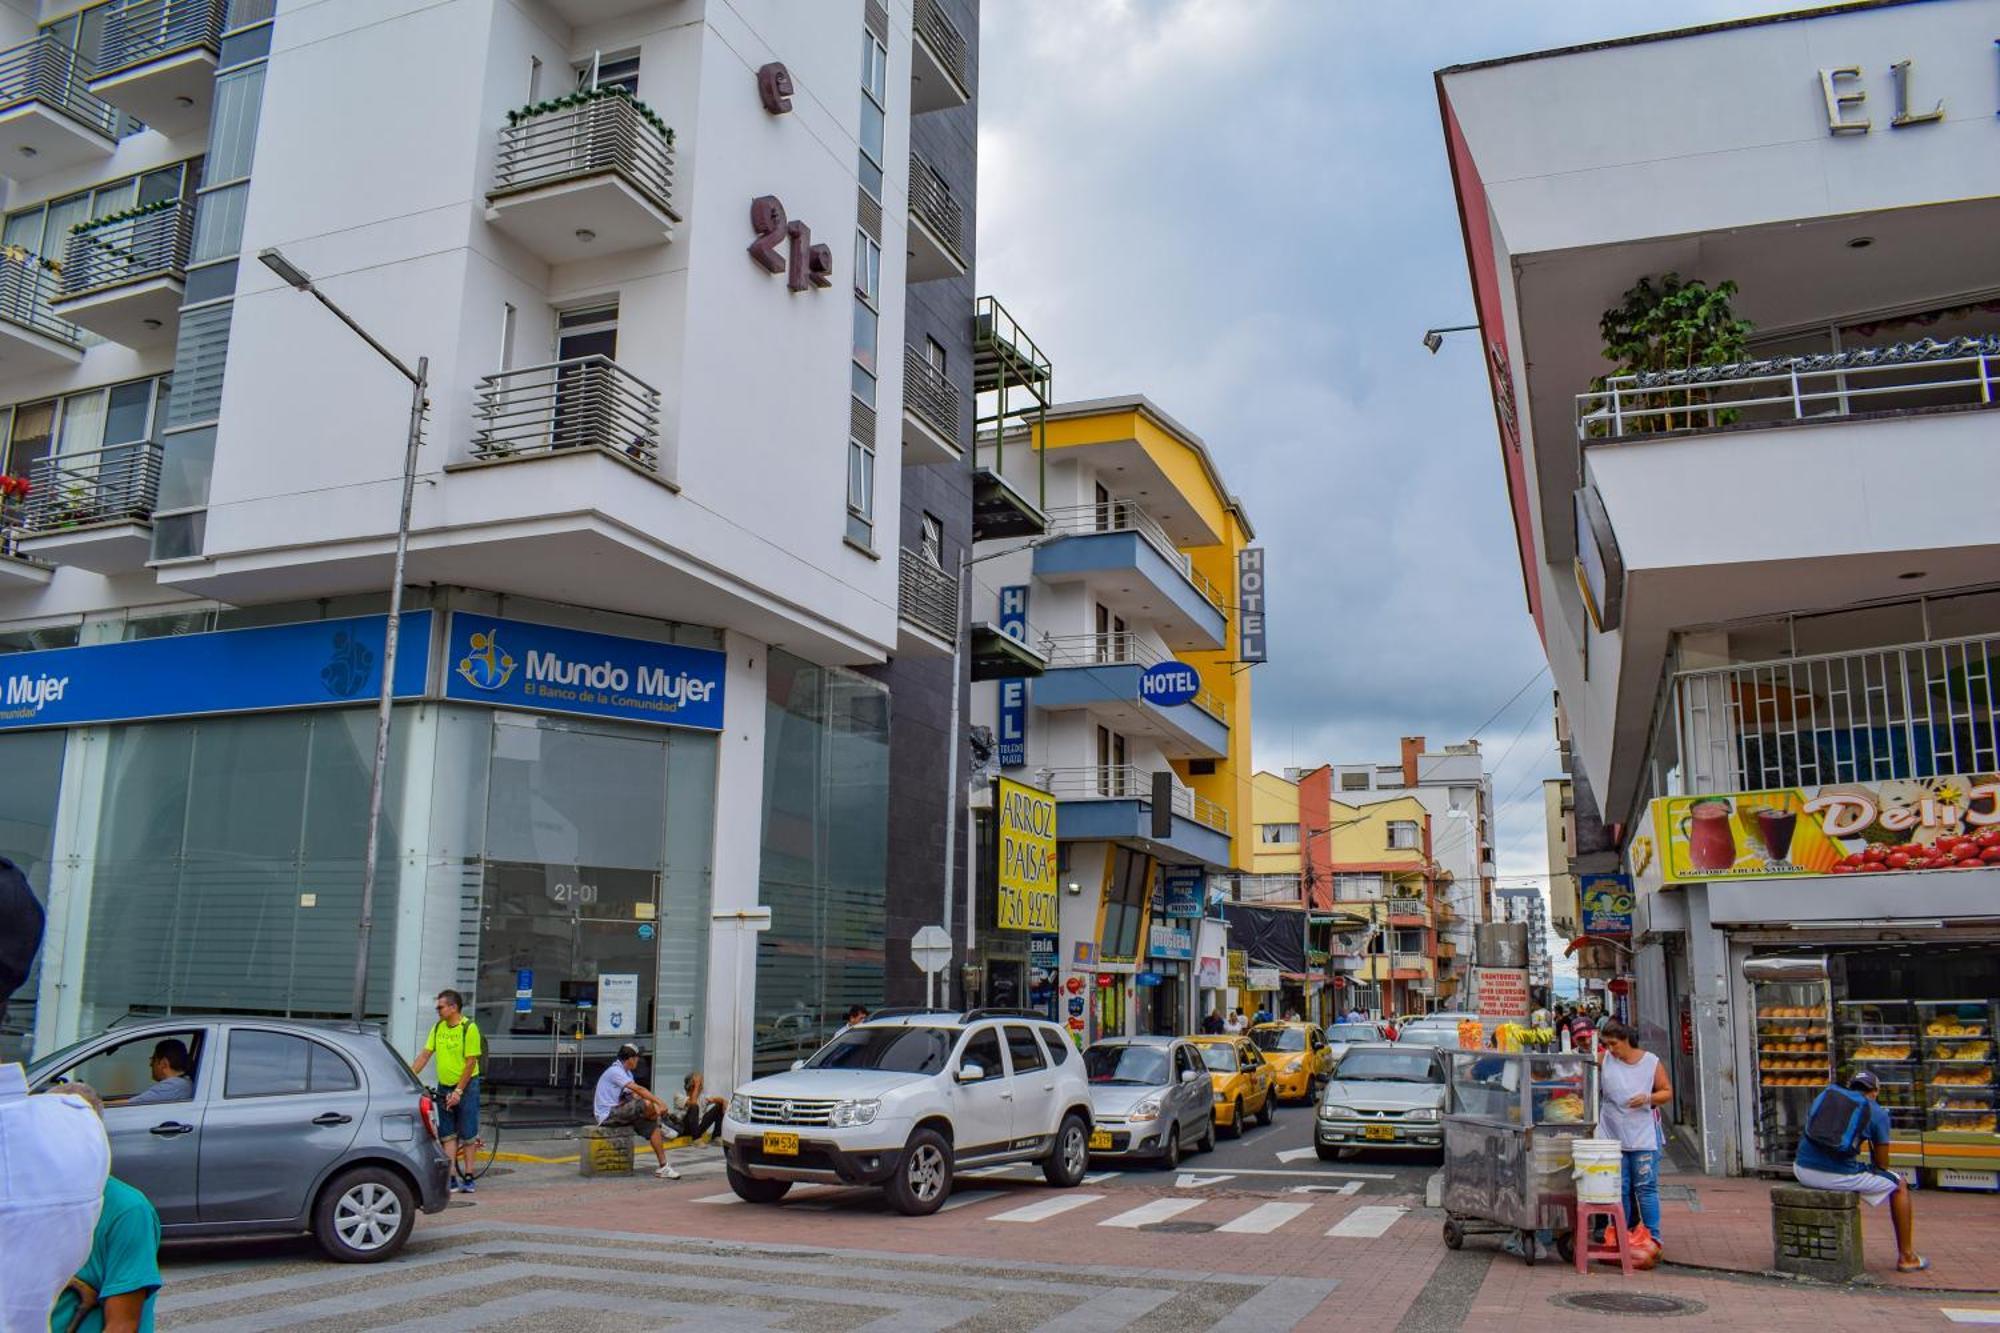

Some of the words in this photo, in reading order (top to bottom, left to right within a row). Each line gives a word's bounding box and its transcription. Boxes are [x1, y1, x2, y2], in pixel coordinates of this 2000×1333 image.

[1818, 60, 1945, 136] EL
[1241, 551, 1263, 658] HOTEL
[525, 649, 629, 692] Mundo
[636, 665, 715, 708] Mujer
[1003, 588, 1025, 740] HOEL
[1143, 672, 1196, 695] HOTEL
[6, 672, 69, 711] Mujer
[539, 684, 576, 701] Banco
[579, 690, 594, 703] de
[597, 692, 608, 704] la
[610, 695, 678, 713] Comunidad
[1001, 790, 1053, 839] ARROZ
[1005, 837, 1049, 883] PAISA
[554, 883, 599, 902] 21-01
[1000, 886, 1024, 927] 736
[1028, 891, 1057, 929] 2270
